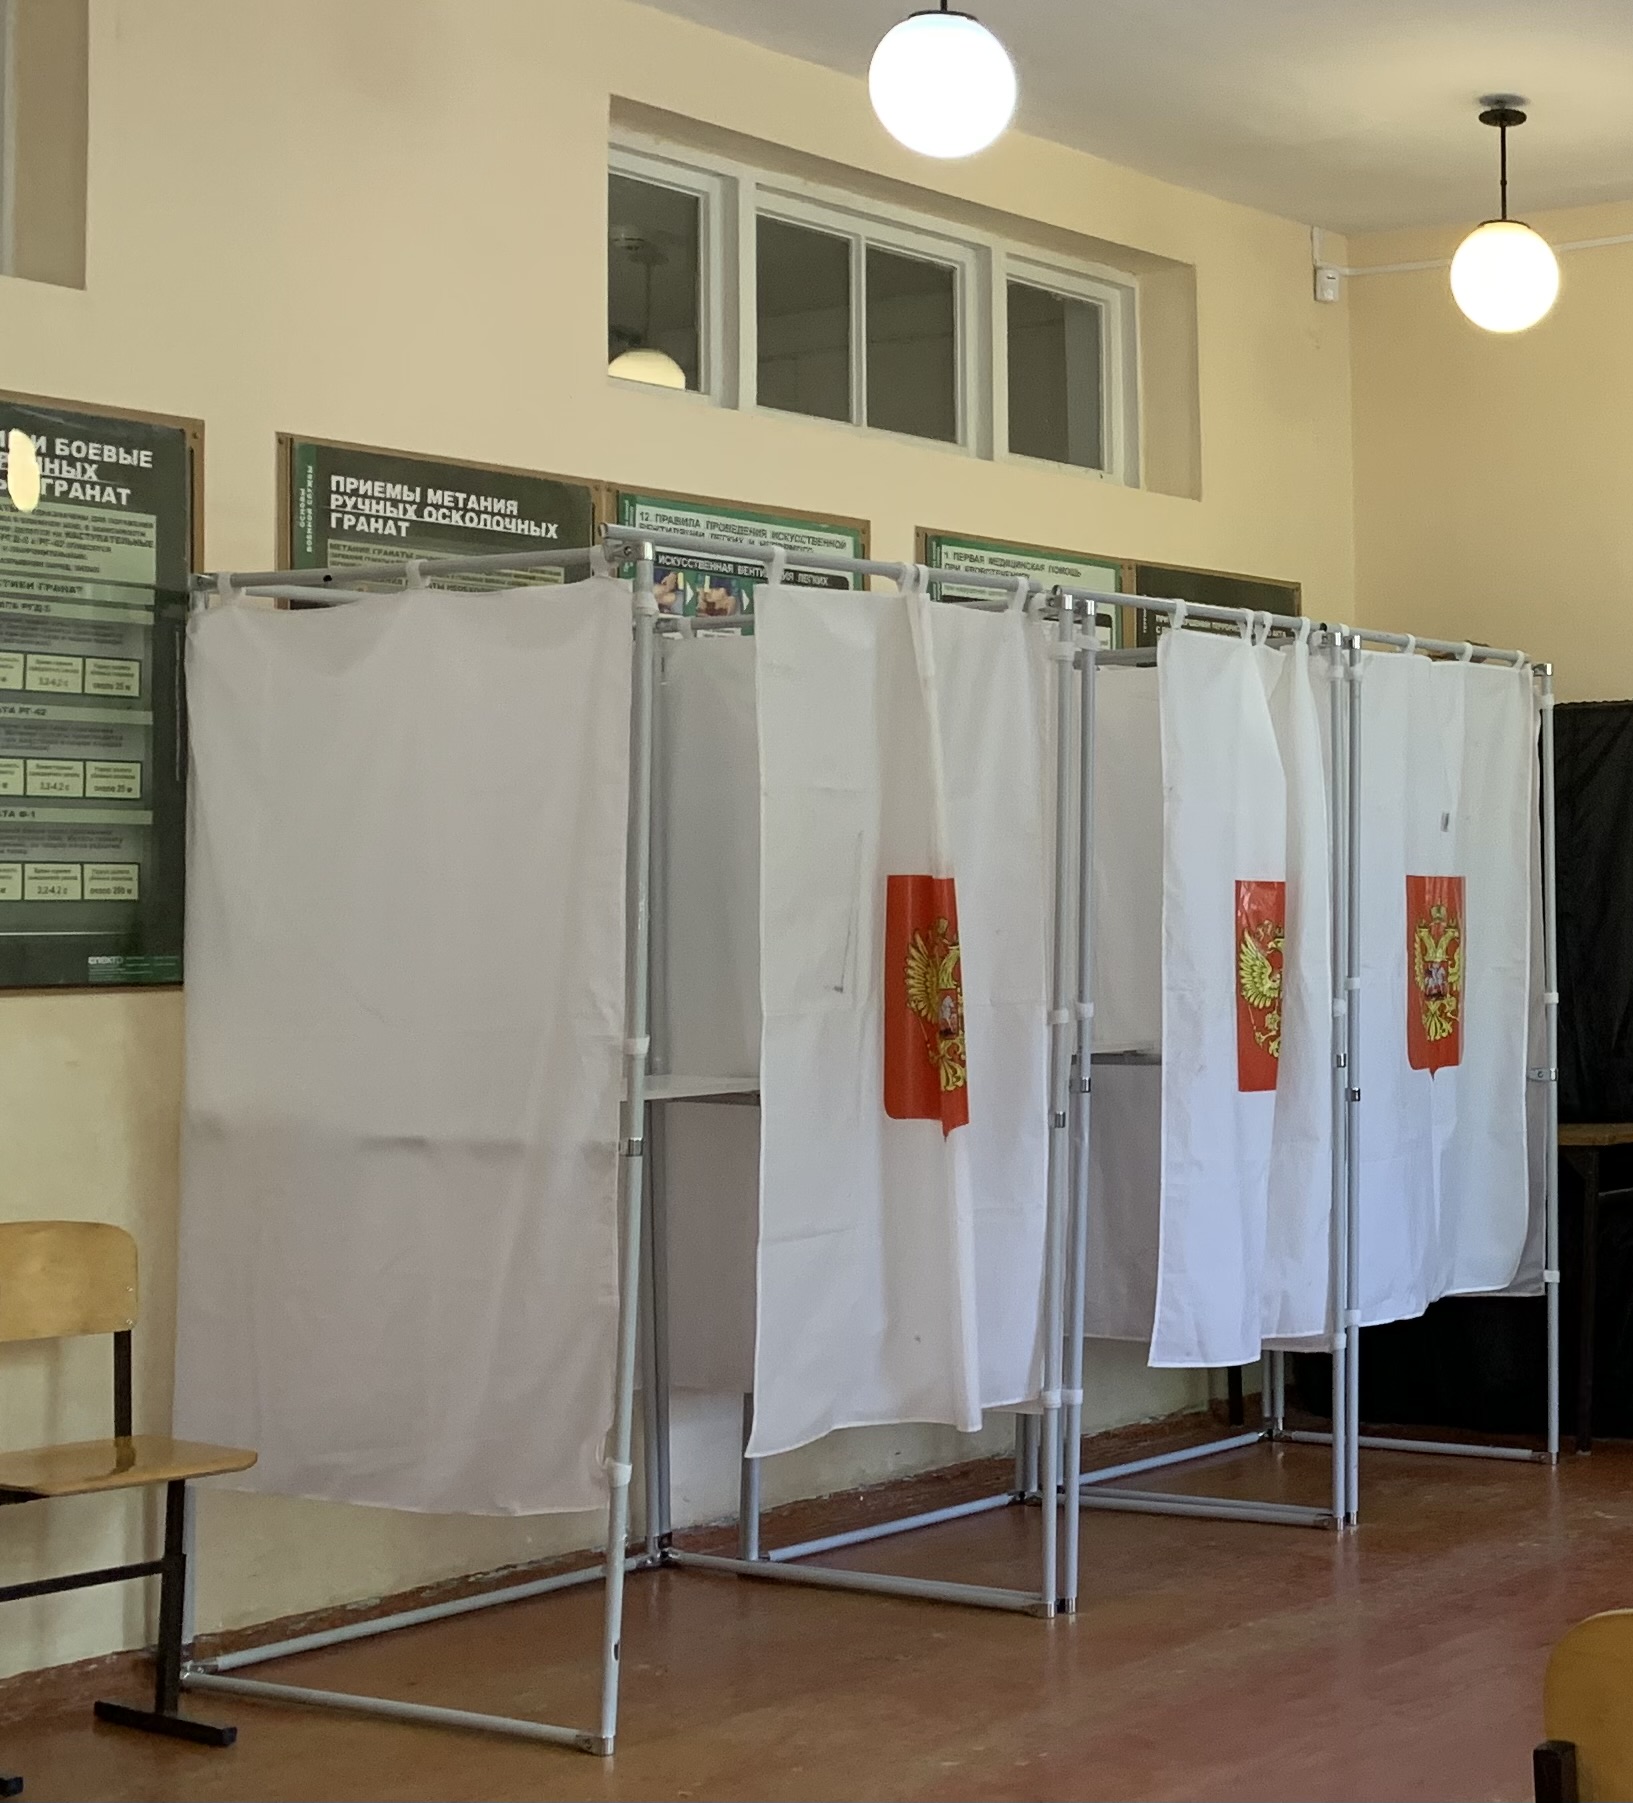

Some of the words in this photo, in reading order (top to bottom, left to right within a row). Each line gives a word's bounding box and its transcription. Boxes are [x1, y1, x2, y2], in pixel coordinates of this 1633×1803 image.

[55, 438, 153, 468] БОЕВЫЕ
[38, 457, 99, 481] НЫХ
[40, 478, 131, 505] ГРАНАТ
[331, 475, 421, 503] ПРИЕМЫ
[427, 488, 519, 515] МЕТАНИЯ
[331, 494, 418, 520] РУЧНЫХ
[423, 506, 559, 539] ОСКОЛОЧНЫХ
[331, 513, 410, 537] ГРАНАТ
[640, 511, 650, 521] 12
[656, 513, 701, 528] ПРАВИЛА
[706, 520, 767, 539] ПРОВЕДЕНИЯ
[659, 555, 734, 574] ИСКУССТВЕННАЯ
[953, 552, 985, 564] ПЕРВАЯ
